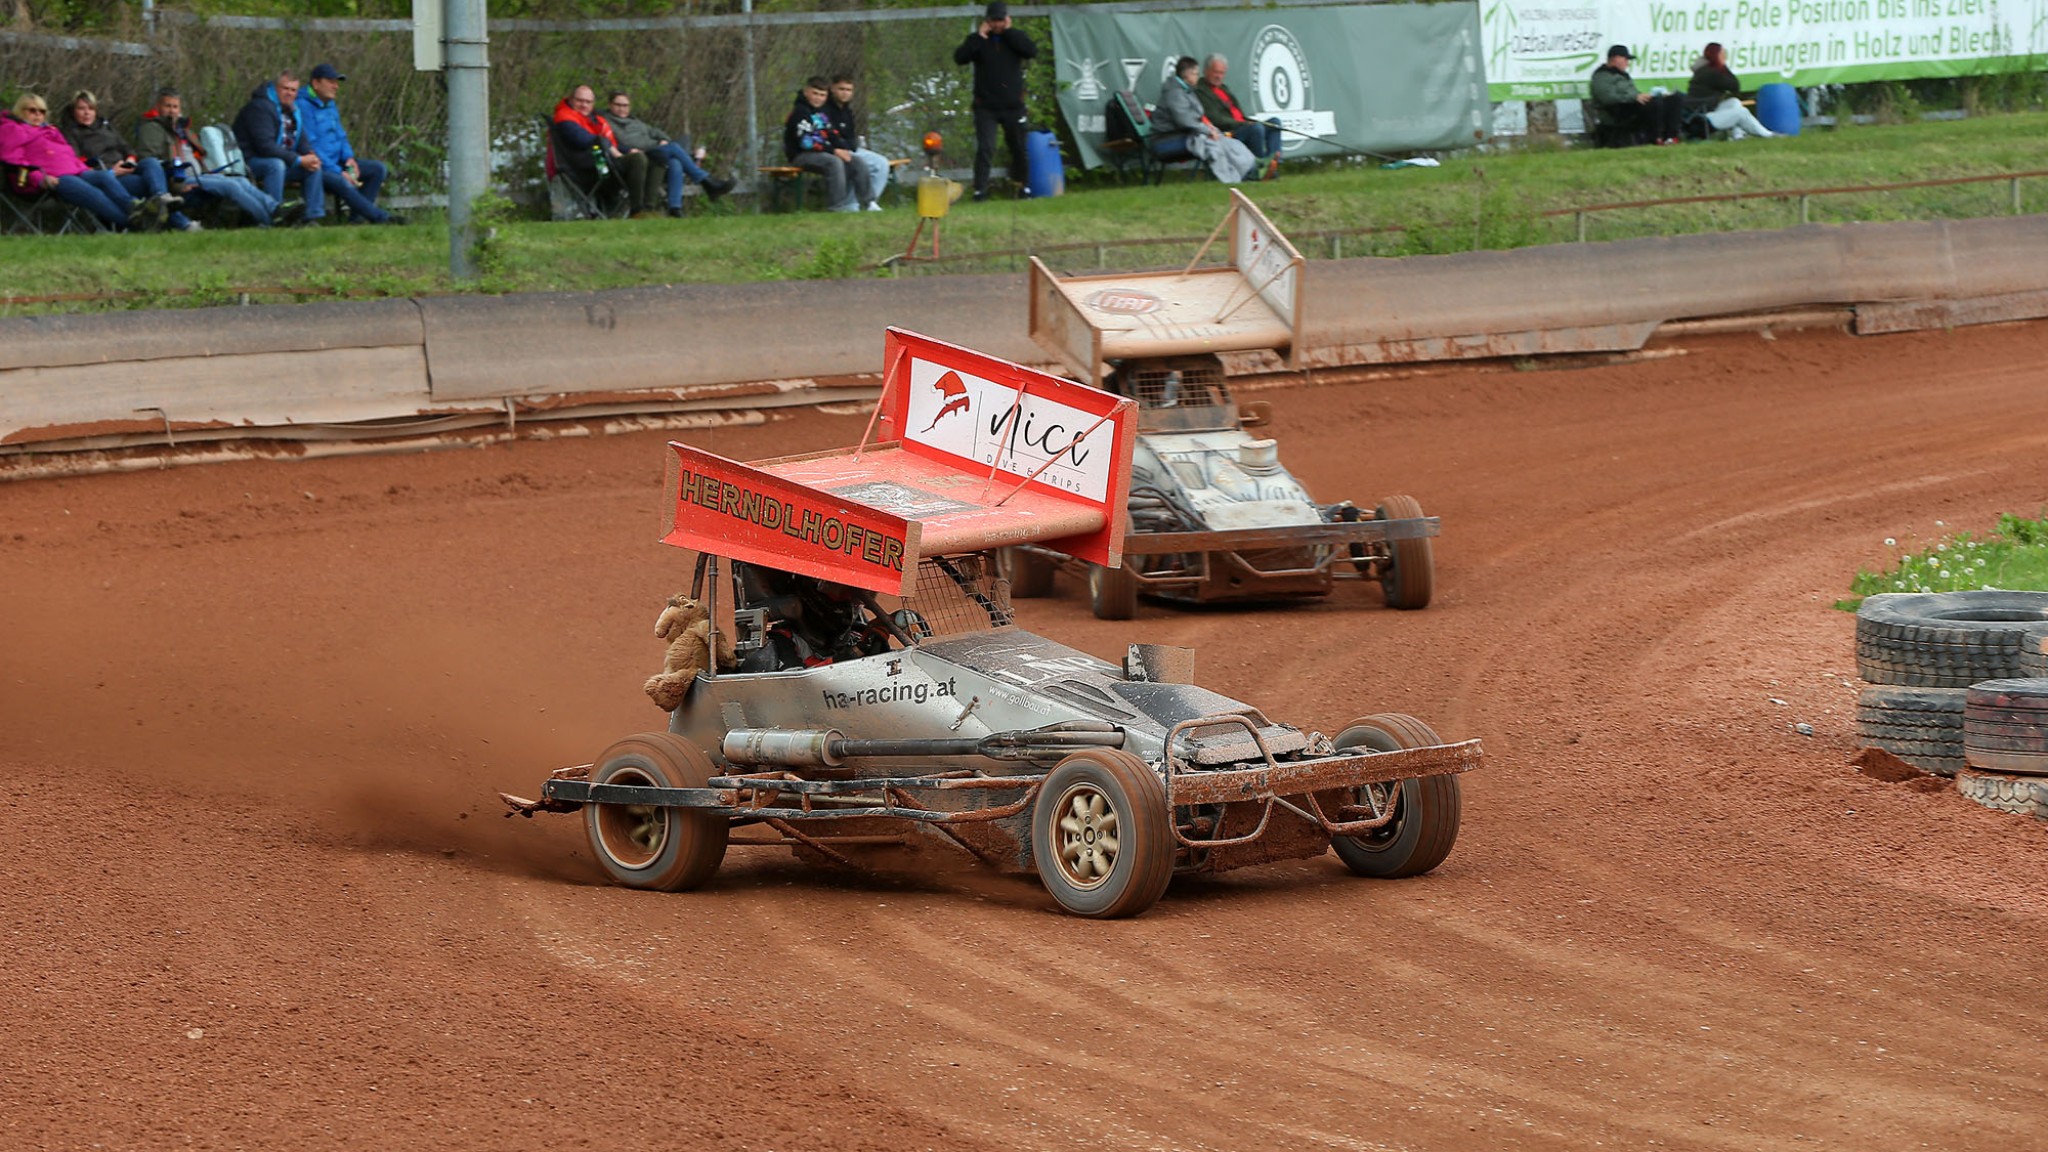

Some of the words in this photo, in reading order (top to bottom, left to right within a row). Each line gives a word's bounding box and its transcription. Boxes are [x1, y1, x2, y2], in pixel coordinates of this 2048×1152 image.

[1649, 2, 1688, 33] Von
[1694, 3, 1730, 31] der
[1735, 0, 1782, 30] Pole
[1787, 0, 1870, 25] Position
[1877, 0, 1907, 19] bis
[1826, 32, 1847, 61] in
[1854, 29, 1902, 58] Holz
[1908, 26, 1944, 56] und
[1274, 70, 1289, 104] 8
[986, 453, 1018, 472] DVE
[1043, 471, 1081, 493] TRIPS
[681, 469, 905, 572] HERNDLHOFER
[823, 675, 957, 711] ha-racing.at
[987, 684, 1052, 716] www.gollbau.at
